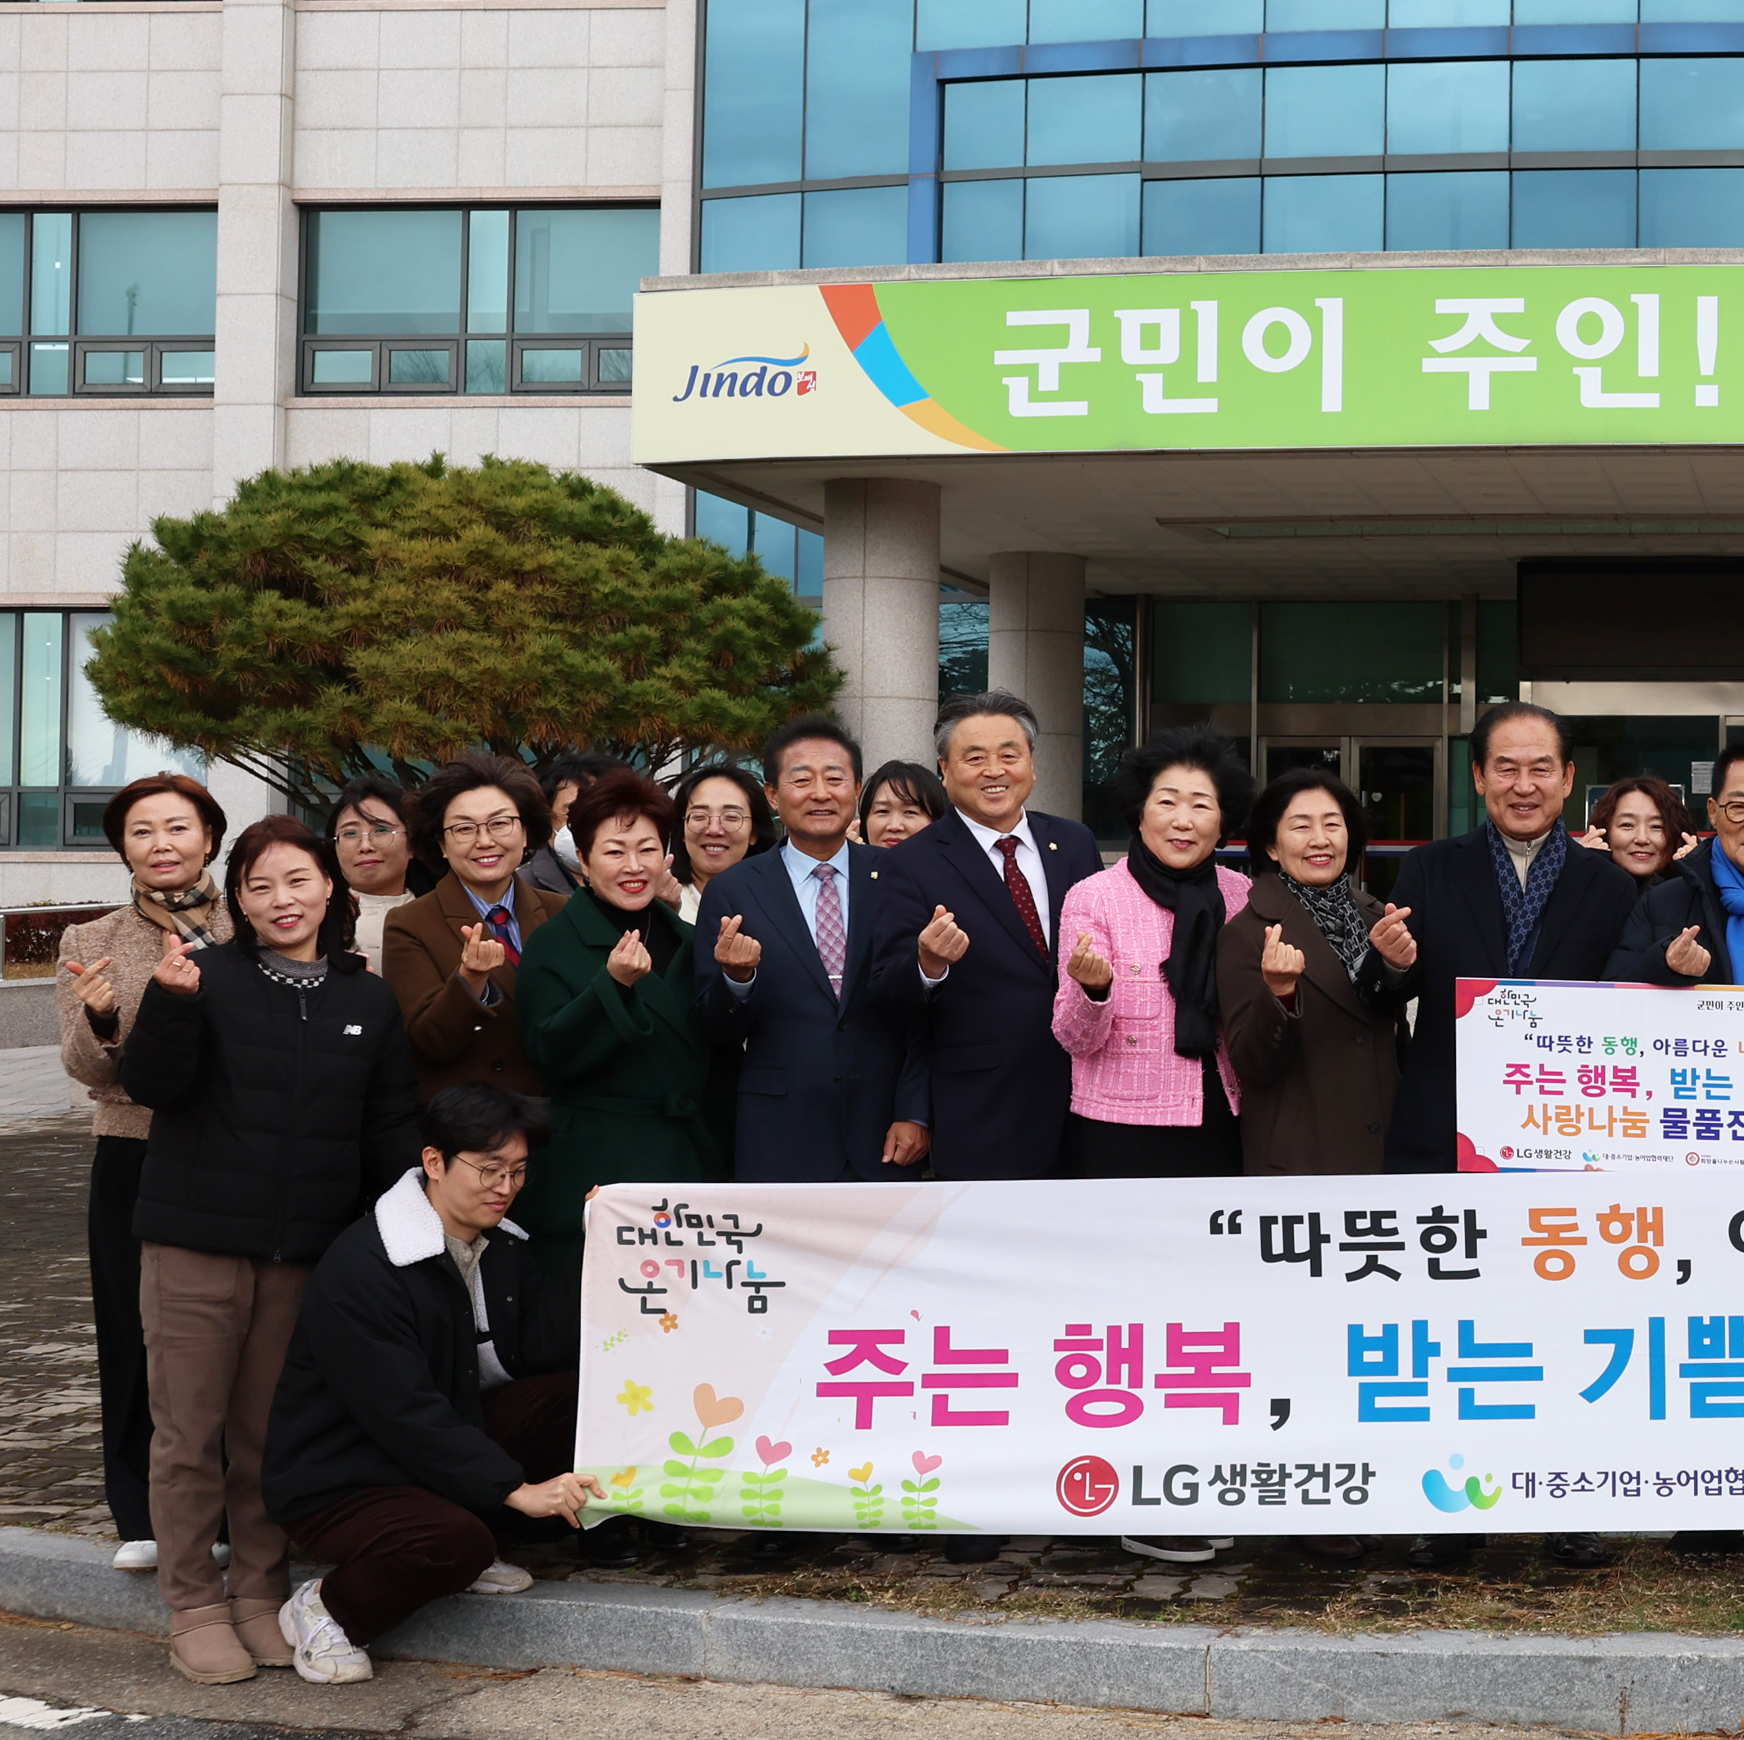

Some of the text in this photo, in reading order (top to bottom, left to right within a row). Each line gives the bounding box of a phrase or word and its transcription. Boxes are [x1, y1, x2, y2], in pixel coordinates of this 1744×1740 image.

[993, 297, 1344, 417] 군민이
[1421, 293, 1720, 411] 주인!
[672, 365, 792, 402] Jindo
[1488, 989, 1536, 1008] 대한민국
[1698, 1001, 1723, 1010] 군민이
[1488, 1009, 1543, 1028] 온기나눔
[1602, 1037, 1644, 1057] 동행,
[1653, 1039, 1728, 1058] 아름다운
[1503, 1063, 1566, 1095] 주는
[1577, 1064, 1652, 1100] 행복,
[1670, 1068, 1733, 1100] 받는
[1521, 1104, 1650, 1138] 사랑나눔
[1517, 1149, 1572, 1159] LG 생활건강
[617, 1198, 762, 1254] 대한민국
[1210, 1205, 1487, 1282] “따뜻한
[1521, 1203, 1691, 1285] 동행,
[618, 1259, 786, 1314] 온기나눔
[816, 1322, 1019, 1430] 주는
[1054, 1322, 1290, 1431] 행복,
[1347, 1320, 1543, 1422] 받는
[1132, 1462, 1376, 1506] LG 생활건강
